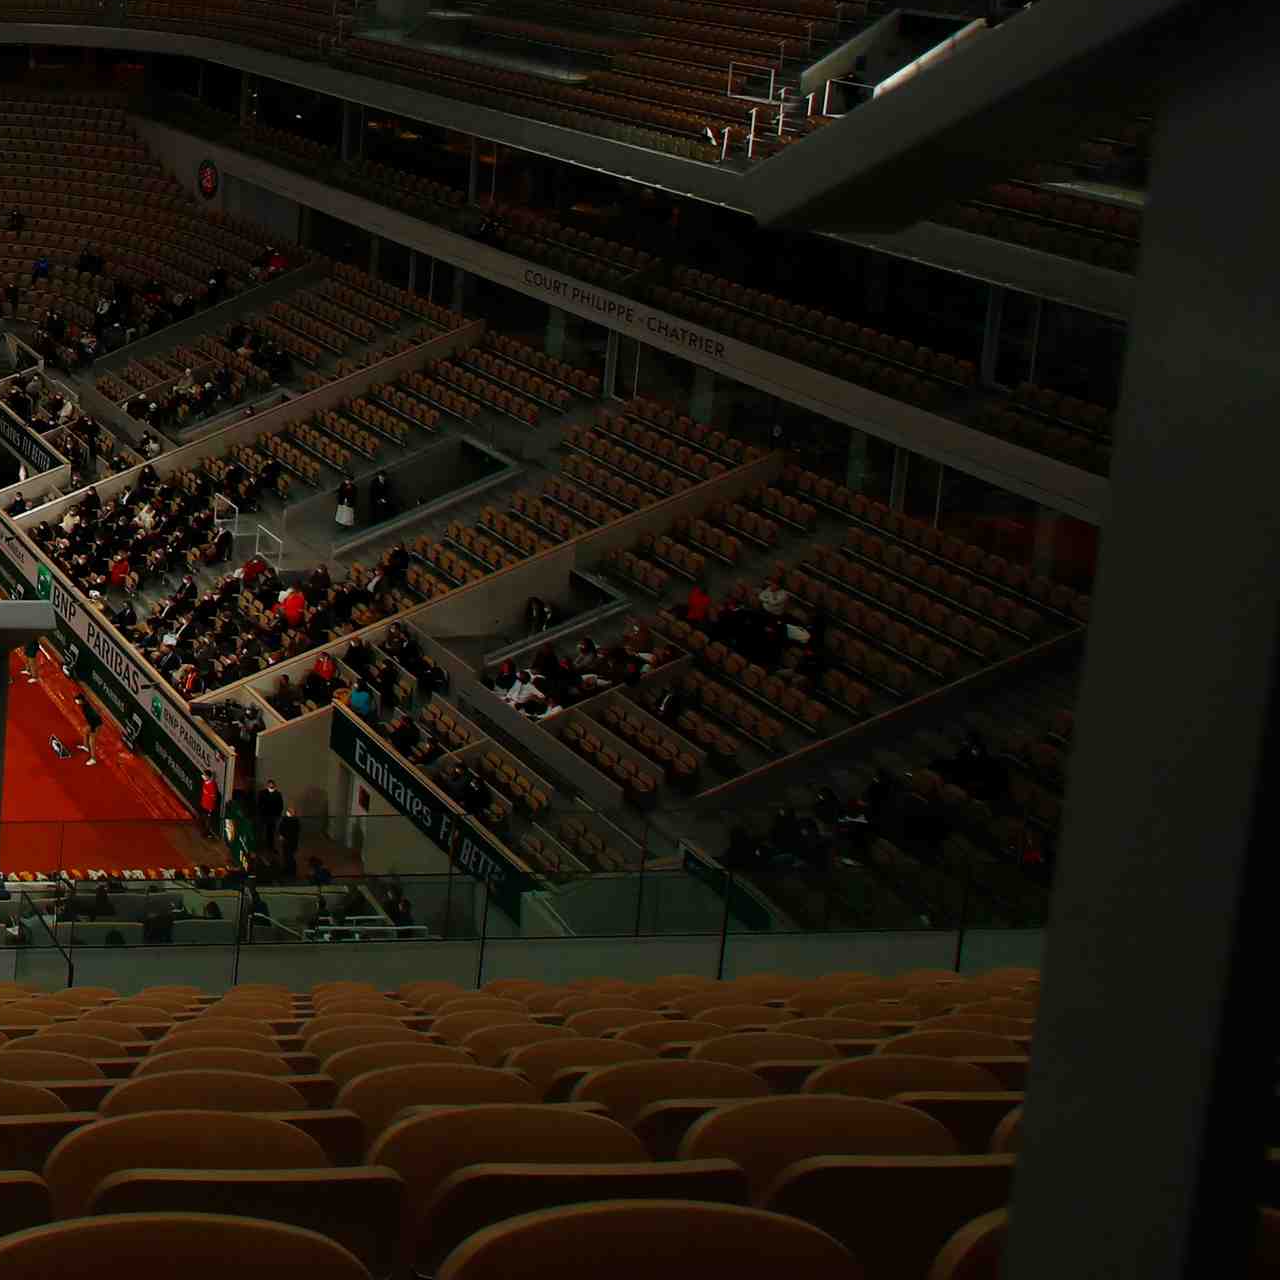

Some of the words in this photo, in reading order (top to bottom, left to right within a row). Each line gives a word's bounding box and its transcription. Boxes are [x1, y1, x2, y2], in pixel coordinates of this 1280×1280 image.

[525, 270, 568, 296] COURT
[572, 287, 634, 322] PHILIPPE
[647, 317, 725, 357] CHATRIER
[54, 586, 77, 622] BNP
[87, 621, 139, 694] PARIBAS
[354, 736, 433, 828] Emirates
